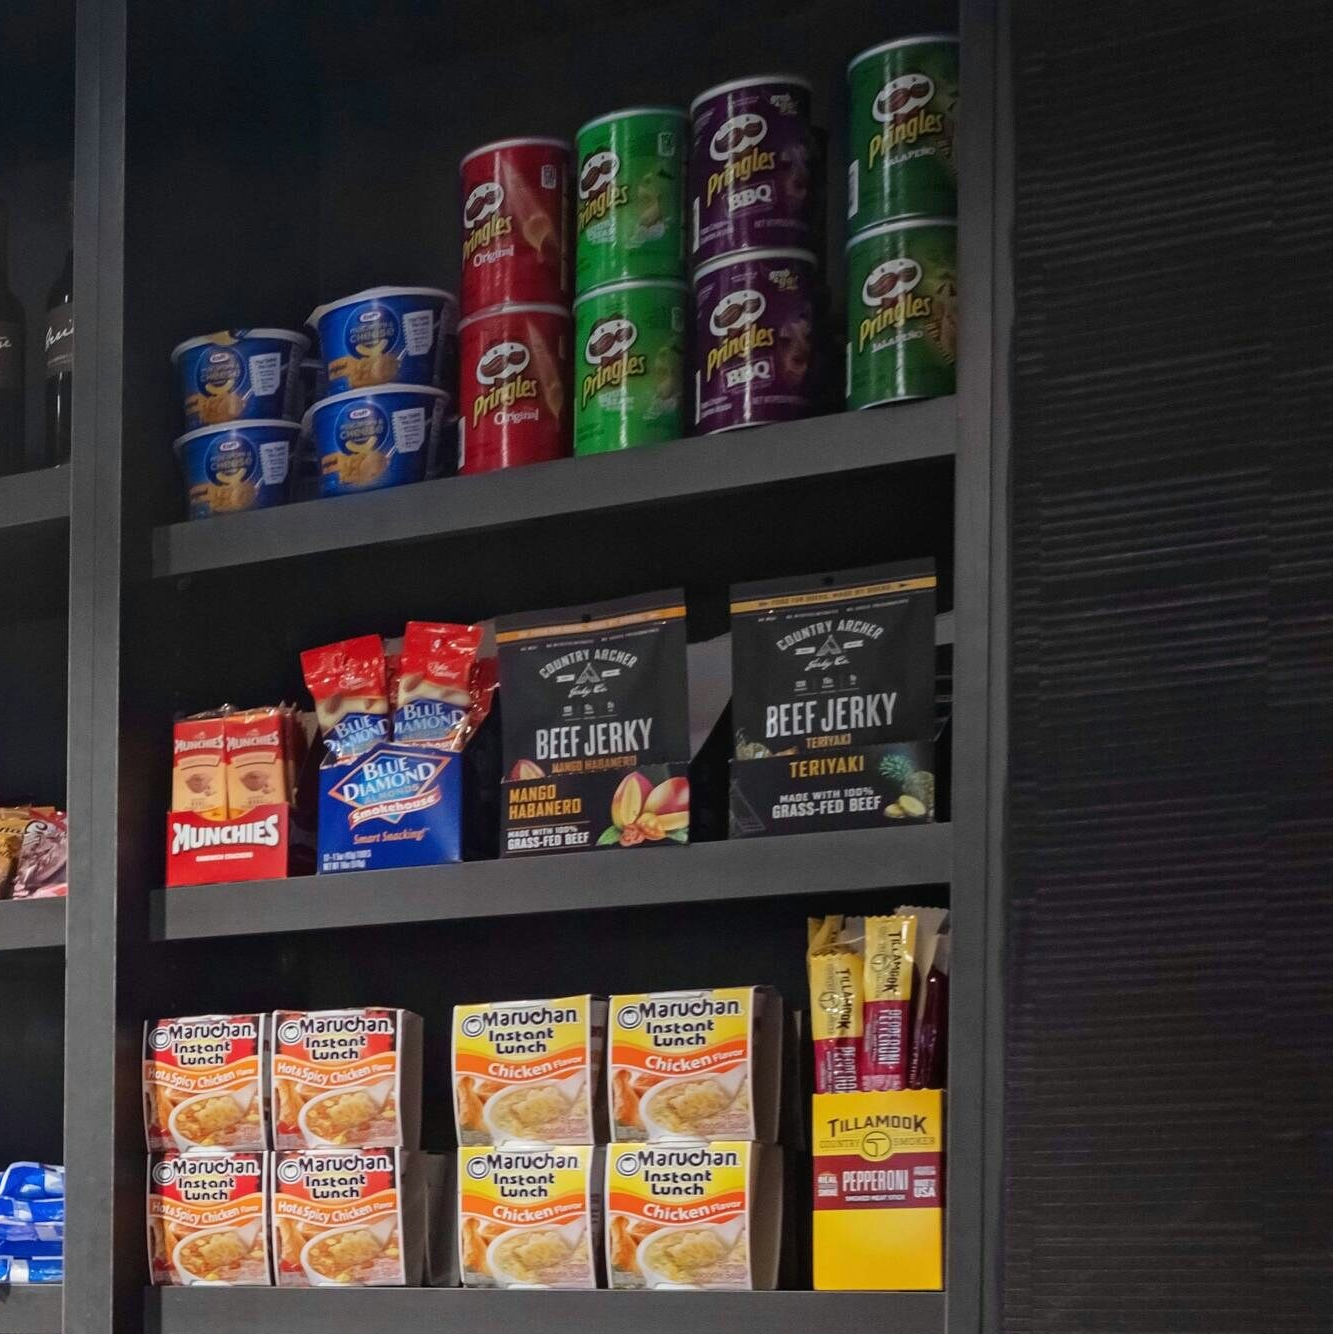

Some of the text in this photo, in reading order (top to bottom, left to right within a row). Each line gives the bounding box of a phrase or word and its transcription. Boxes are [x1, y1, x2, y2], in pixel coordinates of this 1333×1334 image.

[868, 113, 945, 168] Pringles
[707, 150, 775, 206] Pringles
[728, 183, 773, 211] BBQ
[859, 297, 932, 352] Pringles
[706, 323, 775, 380] Pringles
[581, 353, 647, 408] Pringles
[473, 375, 538, 429] Pringles
[493, 408, 539, 426] Original
[776, 618, 885, 653] COUNTRY ARCHER
[538, 648, 639, 681] COUNTRY ARCHER
[404, 700, 444, 720] BLUE
[765, 692, 898, 740] BEEF JERKY
[226, 730, 279, 751] MUNCHIES
[535, 717, 654, 761] BEEF JERKY
[806, 733, 852, 749] TERIYAKI
[363, 755, 409, 782] BLUE
[788, 755, 865, 780] TERIYAKI
[343, 762, 437, 802] DIAMOND
[507, 784, 557, 804] MANGO
[507, 797, 582, 821] HABANERO
[771, 795, 882, 820] GRASS-FED BEEF
[779, 793, 807, 804] MADE
[810, 790, 840, 801] WITH
[351, 796, 438, 823] Smokehouse
[172, 815, 279, 855] MUNCHIES
[507, 830, 590, 851] GRASS-FED BEEF
[884, 930, 903, 994] TILLAMOOK
[483, 1008, 578, 1027] Maruchan
[639, 1000, 740, 1019] Maruchan
[300, 1017, 391, 1035] Maruchan
[488, 1029, 554, 1042] Instant
[646, 1021, 715, 1035] Instant
[305, 1036, 366, 1048] Instant
[496, 1041, 547, 1054] Lunch
[653, 1033, 706, 1047] Lunch
[312, 1049, 358, 1061] Lunch
[644, 1048, 745, 1072] Chicken Flavor
[488, 1055, 583, 1080] Chicken Flavor
[828, 1113, 927, 1138] TILLAMOOK
[638, 1150, 738, 1169] Maruchan
[842, 1169, 909, 1193] PEPPERONI
[914, 1187, 936, 1199] USA
